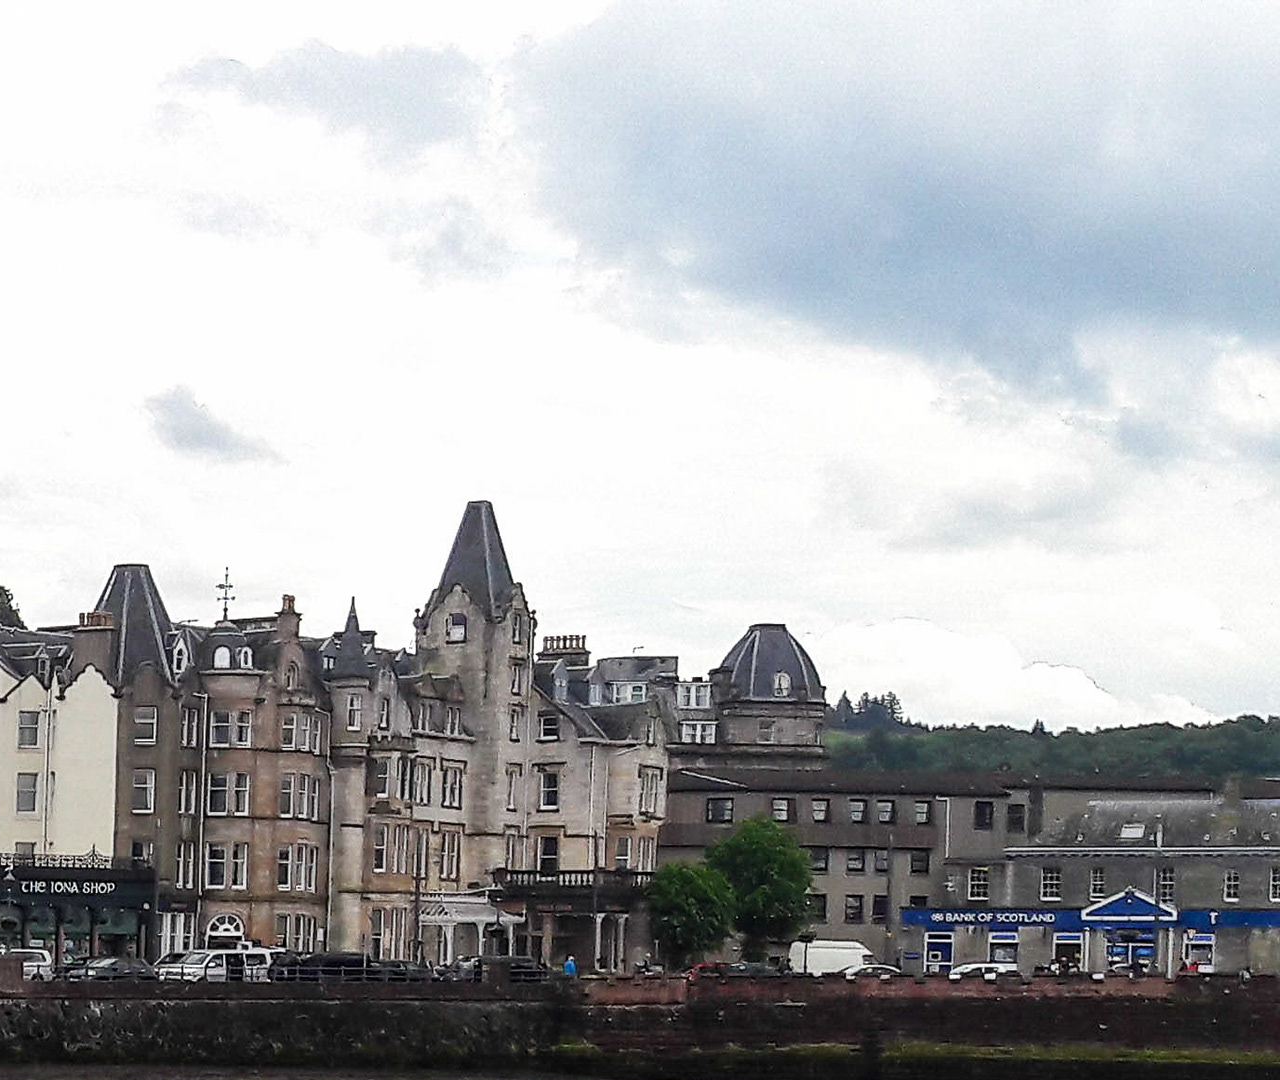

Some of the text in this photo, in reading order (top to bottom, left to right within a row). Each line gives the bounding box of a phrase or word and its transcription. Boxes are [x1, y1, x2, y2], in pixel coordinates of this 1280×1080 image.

[51, 881, 79, 894] IONA
[82, 882, 115, 894] SHOP
[945, 913, 1056, 923] BANK OF SCOTLAND
